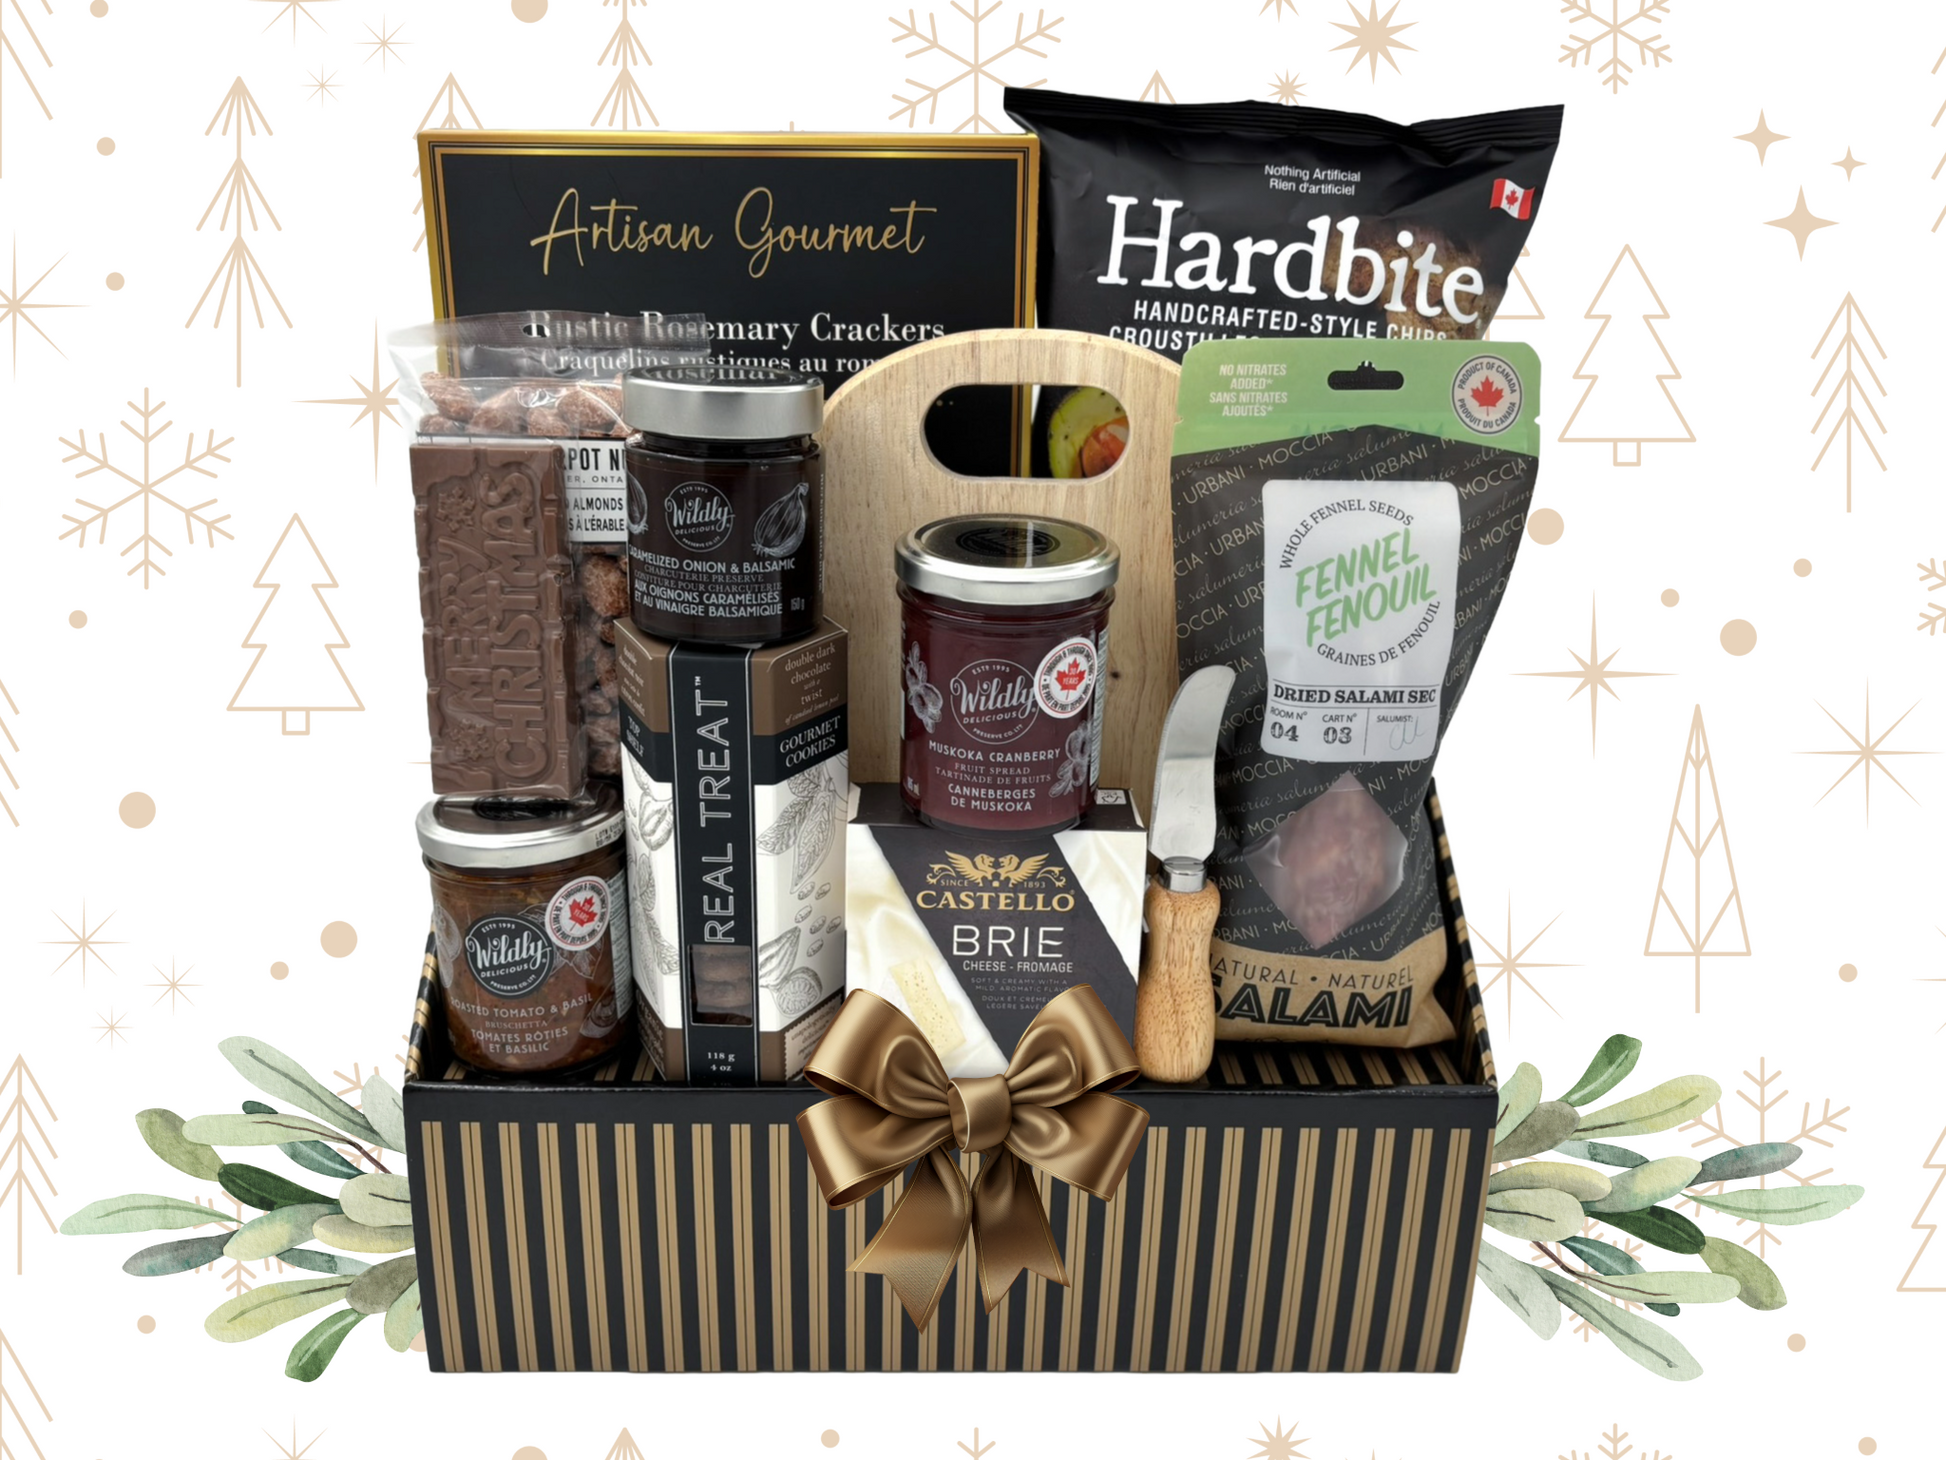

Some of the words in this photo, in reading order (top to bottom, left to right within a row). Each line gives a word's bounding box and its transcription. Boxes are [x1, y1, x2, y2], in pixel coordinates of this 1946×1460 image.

[1264, 165, 1310, 181] Nothing
[1312, 168, 1361, 182] Artificial
[1269, 178, 1296, 192] Rien
[1299, 181, 1355, 196] d'artificiel
[530, 187, 713, 276] Artisan
[735, 187, 938, 278] Gourmet
[1097, 194, 1485, 325] Hardbite
[1133, 299, 1378, 339] HANDCRAFTED-STYLE
[640, 310, 800, 350] Rosemary
[810, 311, 945, 342] Crackers
[799, 357, 828, 373] au
[1219, 364, 1234, 376] NO
[1236, 364, 1287, 376] NITRATES
[1457, 361, 1484, 390] PRODUCT
[1485, 361, 1496, 371] OF
[1495, 364, 1517, 395] CANADA
[1209, 392, 1237, 404] SANS
[1239, 392, 1288, 404] NITRATES
[1457, 398, 1482, 427] PRODUIT
[1482, 420, 1494, 429] DU
[1494, 401, 1517, 427] CANADA
[1182, 465, 1246, 505] URBANI
[1258, 431, 1334, 470] MOCCIA
[1458, 457, 1528, 500] MOCCIA
[572, 497, 624, 511] ALMONDS
[664, 495, 736, 533] Wildly
[674, 525, 716, 536] DELICIOUS
[1279, 519, 1313, 570] WHOLE
[1310, 499, 1366, 525] FENNEL
[1369, 499, 1414, 527] SEEDS
[644, 564, 710, 583] CHARCUTERIE
[712, 573, 765, 583] PRESERVE
[683, 559, 726, 574] ONION
[730, 562, 739, 574] &
[743, 557, 796, 573] BALSAMIC
[1295, 527, 1420, 609] FENNEL
[634, 579, 648, 594] AUX
[648, 584, 700, 604] OIGNONS
[678, 580, 706, 592] POUR
[708, 582, 783, 593] CHARCUTERIE
[634, 590, 642, 604] ET
[642, 594, 654, 608] AU
[655, 598, 705, 617] VINAIGRE
[708, 603, 783, 618] BALSAMIQUE
[1306, 562, 1437, 648] FENOUIL
[437, 536, 495, 717] MERRY
[480, 472, 547, 778] CHRISTMAS
[1316, 643, 1376, 667] GRAINES
[1378, 646, 1399, 664] DE
[1397, 600, 1441, 654] FENOUIL
[784, 651, 815, 672] double
[816, 642, 836, 659] dark
[790, 661, 832, 685] chocolate
[992, 664, 1010, 673] 1995
[1062, 677, 1080, 685] YEARS
[950, 675, 1038, 720] Wildly
[1273, 683, 1331, 704] DRIED
[1334, 689, 1405, 704] SALAMI
[1407, 688, 1437, 704] SEC
[962, 712, 1017, 725] DELICIOUS
[1269, 706, 1294, 720] ROOM
[1322, 714, 1345, 723] CART
[780, 715, 841, 754] GOURMET
[972, 727, 1003, 739] PRESERVE
[1270, 721, 1299, 742] 04
[695, 689, 732, 828] TREAT
[785, 734, 836, 768] COOKIES
[929, 740, 984, 762] MUSKOKA
[989, 748, 1061, 763] CRANBERRY
[935, 767, 993, 785] TARTINADE
[997, 777, 1012, 785] DE
[1015, 774, 1052, 785] FRUITS
[954, 762, 986, 775] FRUIT
[989, 767, 1031, 775] SPREAD
[948, 783, 1036, 799] CANNEBERGES
[951, 796, 966, 809] DE
[971, 800, 1033, 812] MUSKOKA
[702, 842, 735, 943] REAL
[940, 878, 969, 887] SINCE
[1023, 881, 1046, 889] 1893
[916, 890, 1075, 912] CASTELLO
[465, 930, 552, 970] Wildly
[952, 924, 1064, 958] BRIE
[480, 963, 529, 978] DELICIOUS
[963, 960, 1007, 972] CHEESE
[1017, 961, 1073, 973] FROMAGE
[1209, 953, 1299, 986] ATURAL
[1328, 964, 1414, 990] NATUREL
[1000, 985, 1041, 993] AROMATIC
[493, 1006, 545, 1018] TOMATO
[562, 993, 593, 1011] BASIL
[471, 1028, 520, 1043] TOMATES
[525, 1026, 569, 1042] RÔTIES
[485, 1020, 548, 1030] BRUSCHETTA
[489, 1043, 501, 1053] ET
[505, 1042, 551, 1054] BASILIC
[707, 1052, 725, 1060] 118
[710, 1064, 717, 1072] 4
[719, 1064, 732, 1072] oz
